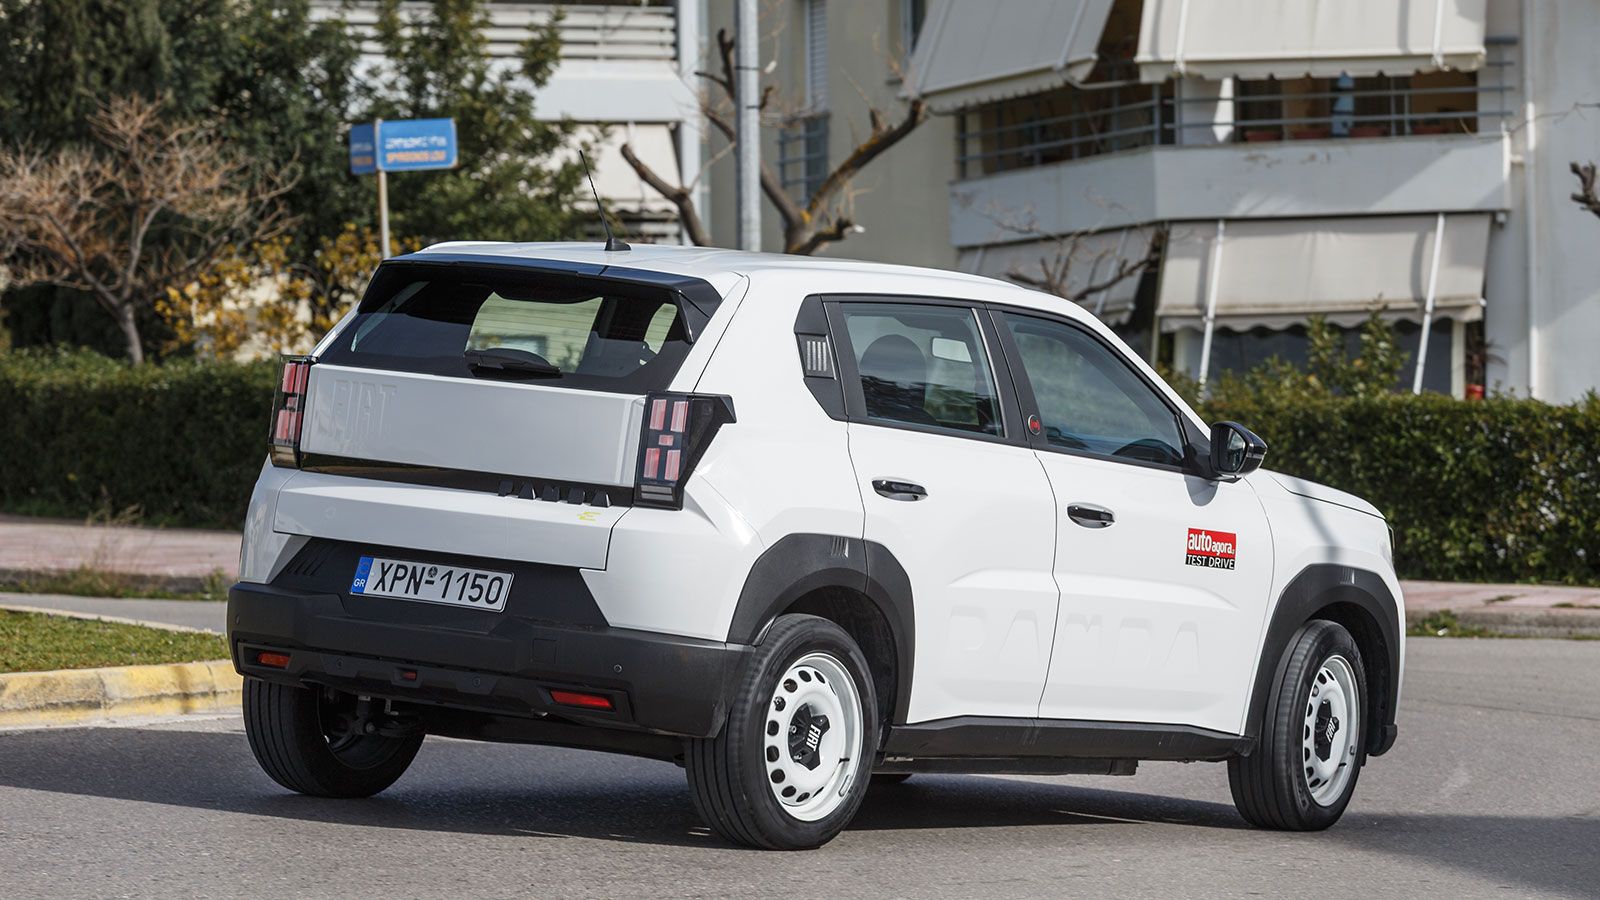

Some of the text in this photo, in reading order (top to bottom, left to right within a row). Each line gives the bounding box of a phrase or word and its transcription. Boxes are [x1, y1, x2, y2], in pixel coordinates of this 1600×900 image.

[1187, 555, 1235, 569] TEST DRIVE
[353, 578, 365, 588] GR
[806, 724, 821, 751] FIAT
